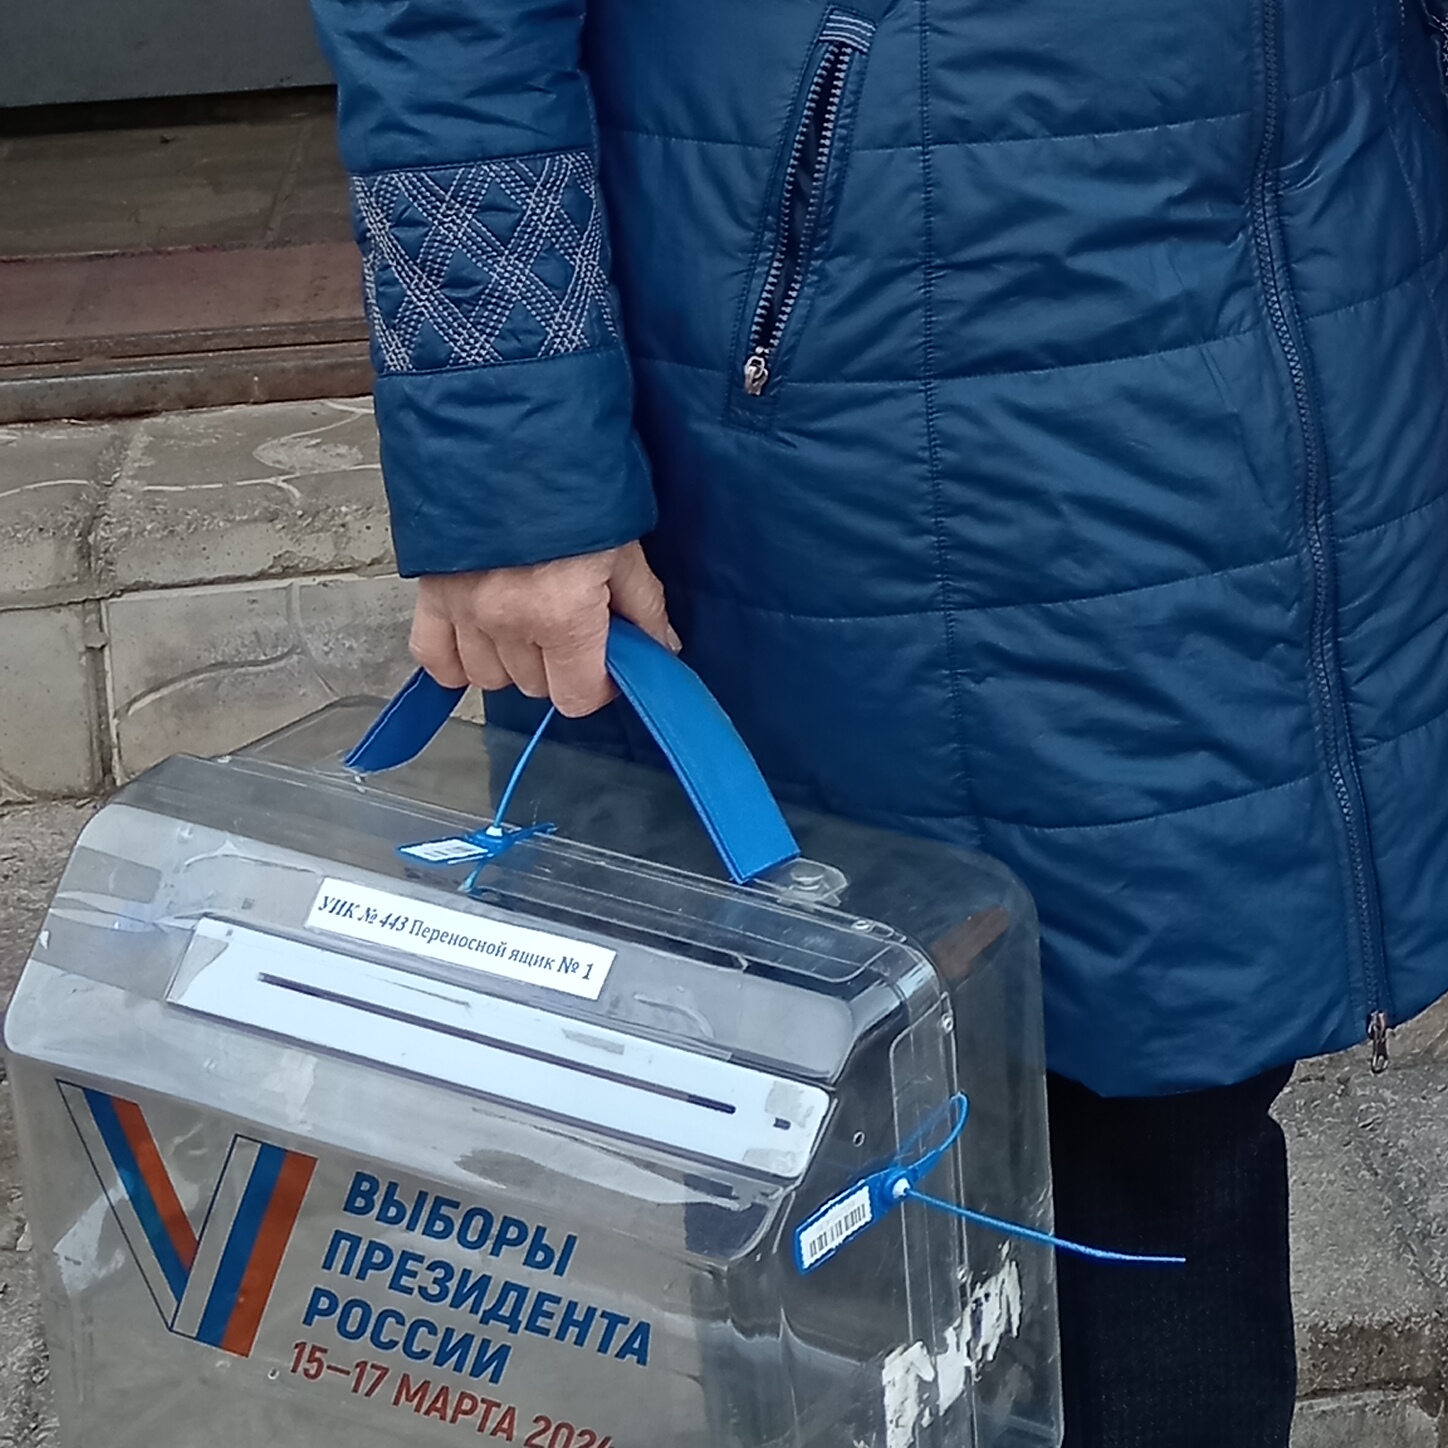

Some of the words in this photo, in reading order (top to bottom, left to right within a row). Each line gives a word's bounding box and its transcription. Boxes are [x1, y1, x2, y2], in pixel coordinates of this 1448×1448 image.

[318, 895, 361, 920] УИК
[357, 906, 378, 925] №
[378, 912, 410, 932] 443
[409, 918, 508, 958] Переносной
[508, 947, 556, 971] ящик
[556, 956, 580, 975] №
[582, 962, 594, 980] 1
[342, 1171, 578, 1278] ВЫБОРЫ
[302, 1287, 512, 1385] РОССИИ
[321, 1229, 652, 1367] ПРЕЗИДЕНТА
[392, 1373, 517, 1443] МАРТА
